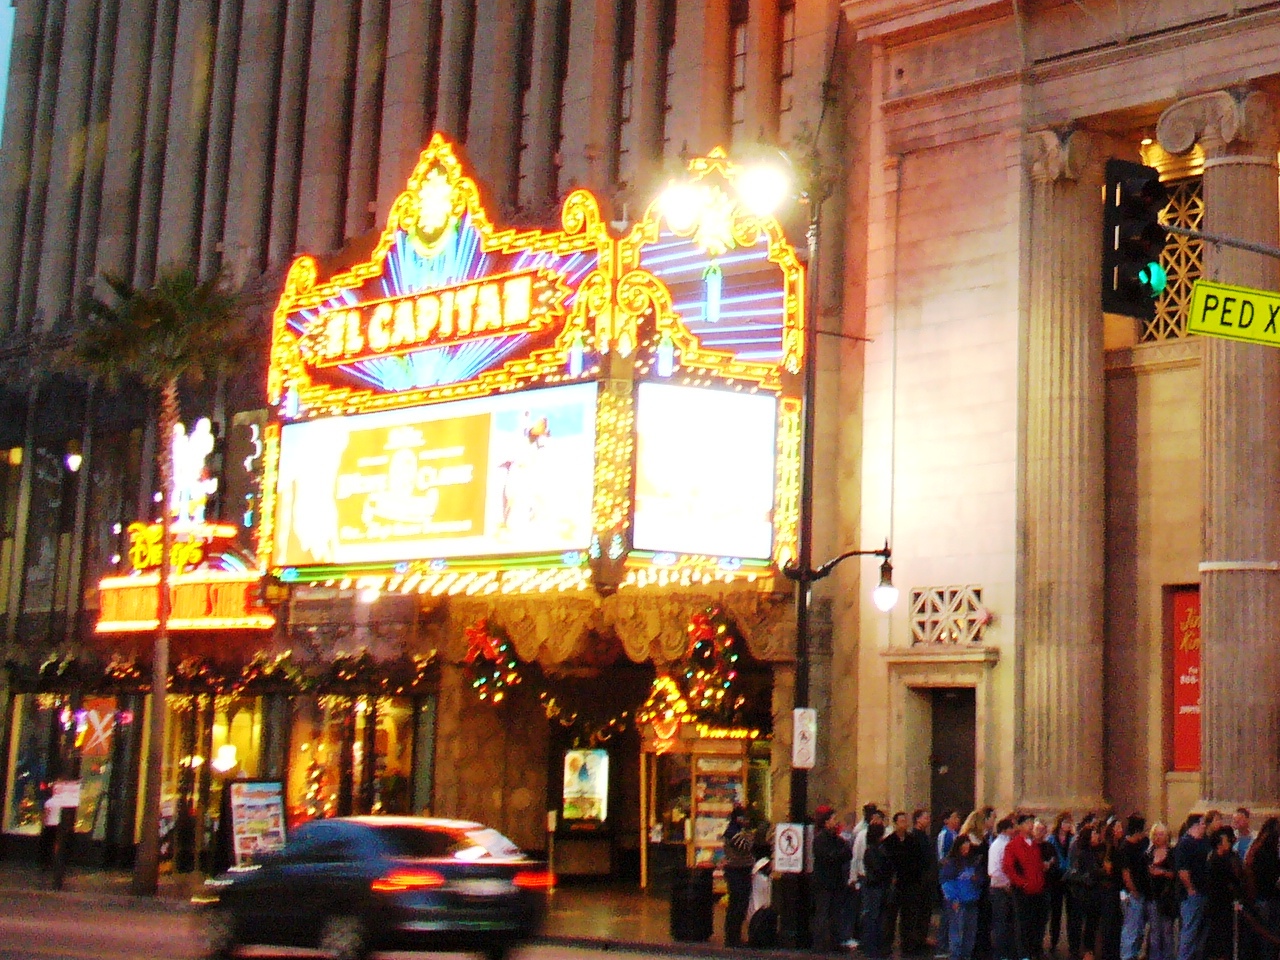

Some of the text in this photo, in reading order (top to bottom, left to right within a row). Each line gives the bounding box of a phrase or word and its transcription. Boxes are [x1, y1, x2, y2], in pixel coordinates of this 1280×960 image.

[326, 276, 532, 359] EL CAPITAN
[1201, 294, 1255, 329] PED
